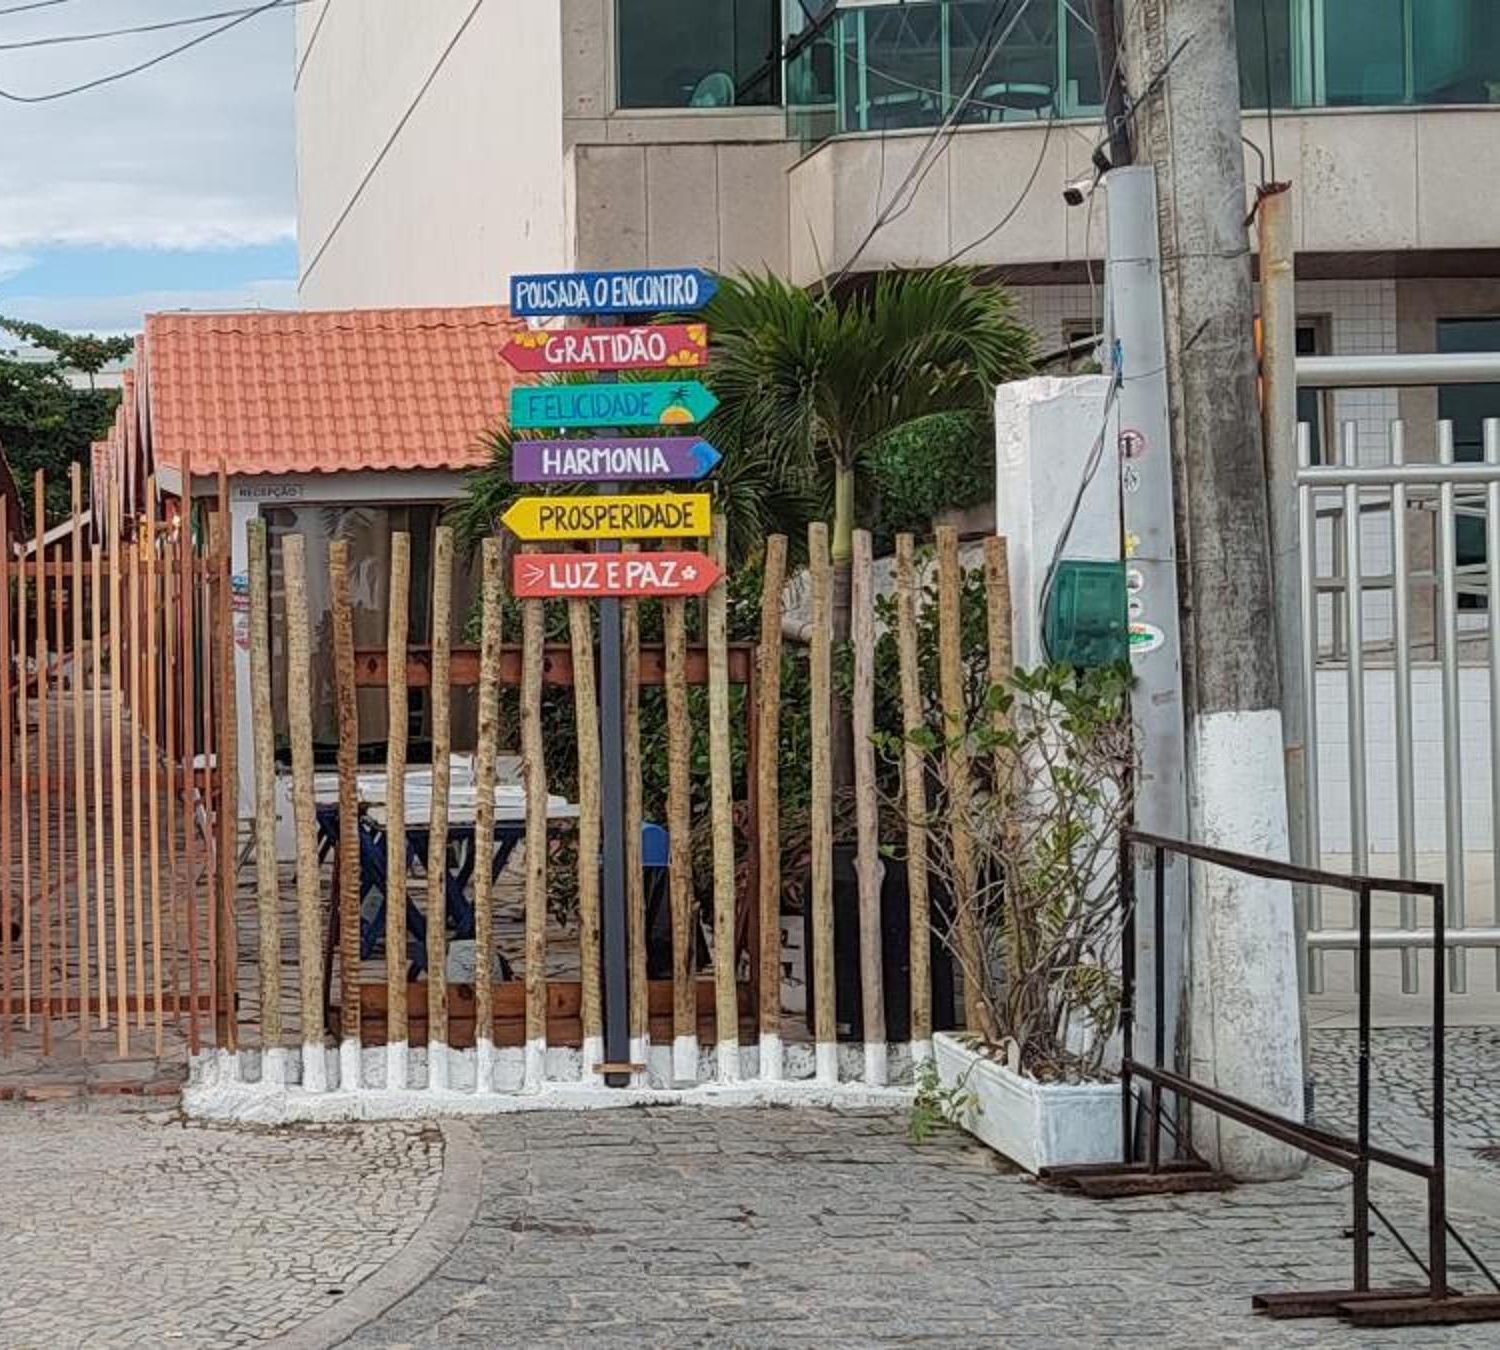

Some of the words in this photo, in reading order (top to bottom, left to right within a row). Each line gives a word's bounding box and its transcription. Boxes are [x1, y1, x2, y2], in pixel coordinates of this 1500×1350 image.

[516, 280, 590, 309] POUSADA
[595, 278, 608, 307] O
[612, 274, 699, 306] ENCONTRO
[545, 330, 667, 364] GRATIDÃO
[528, 391, 652, 421] FELICIDADE
[541, 447, 671, 475] HARMONIA
[539, 502, 695, 531] PROSPERIDADE
[549, 562, 600, 589] LUZ
[607, 563, 619, 588] E
[626, 561, 681, 588] PAZ
